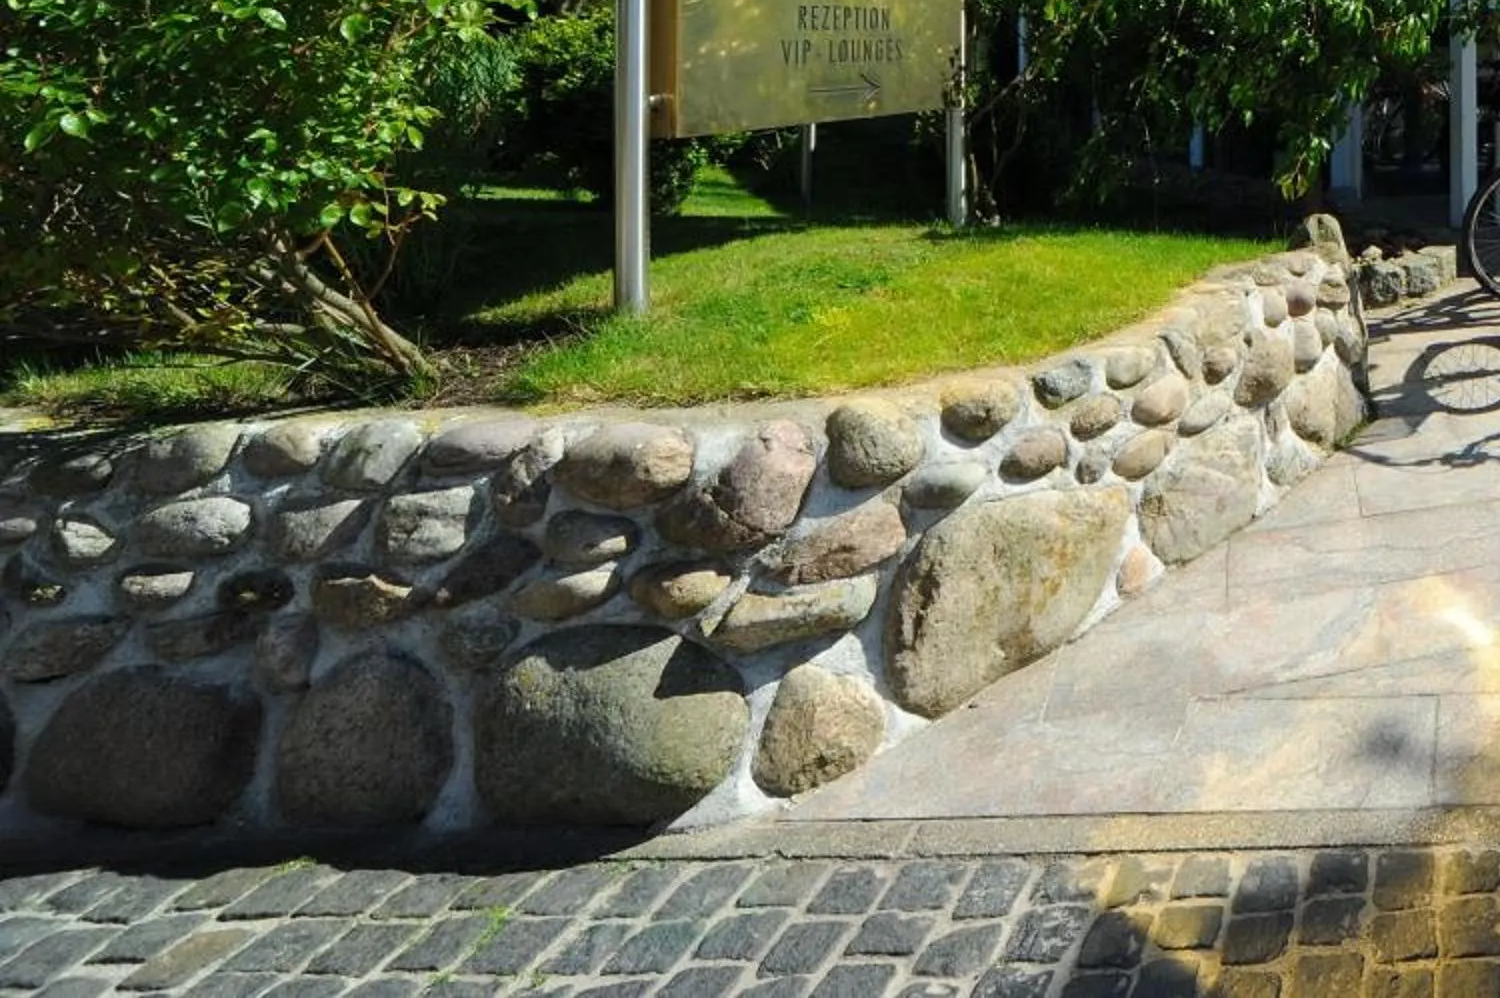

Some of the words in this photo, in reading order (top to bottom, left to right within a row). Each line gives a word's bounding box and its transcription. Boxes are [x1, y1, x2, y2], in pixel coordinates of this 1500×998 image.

[797, 4, 891, 32] REZEPTION
[780, 39, 811, 65] VIP
[828, 38, 903, 64] LOUNGES
